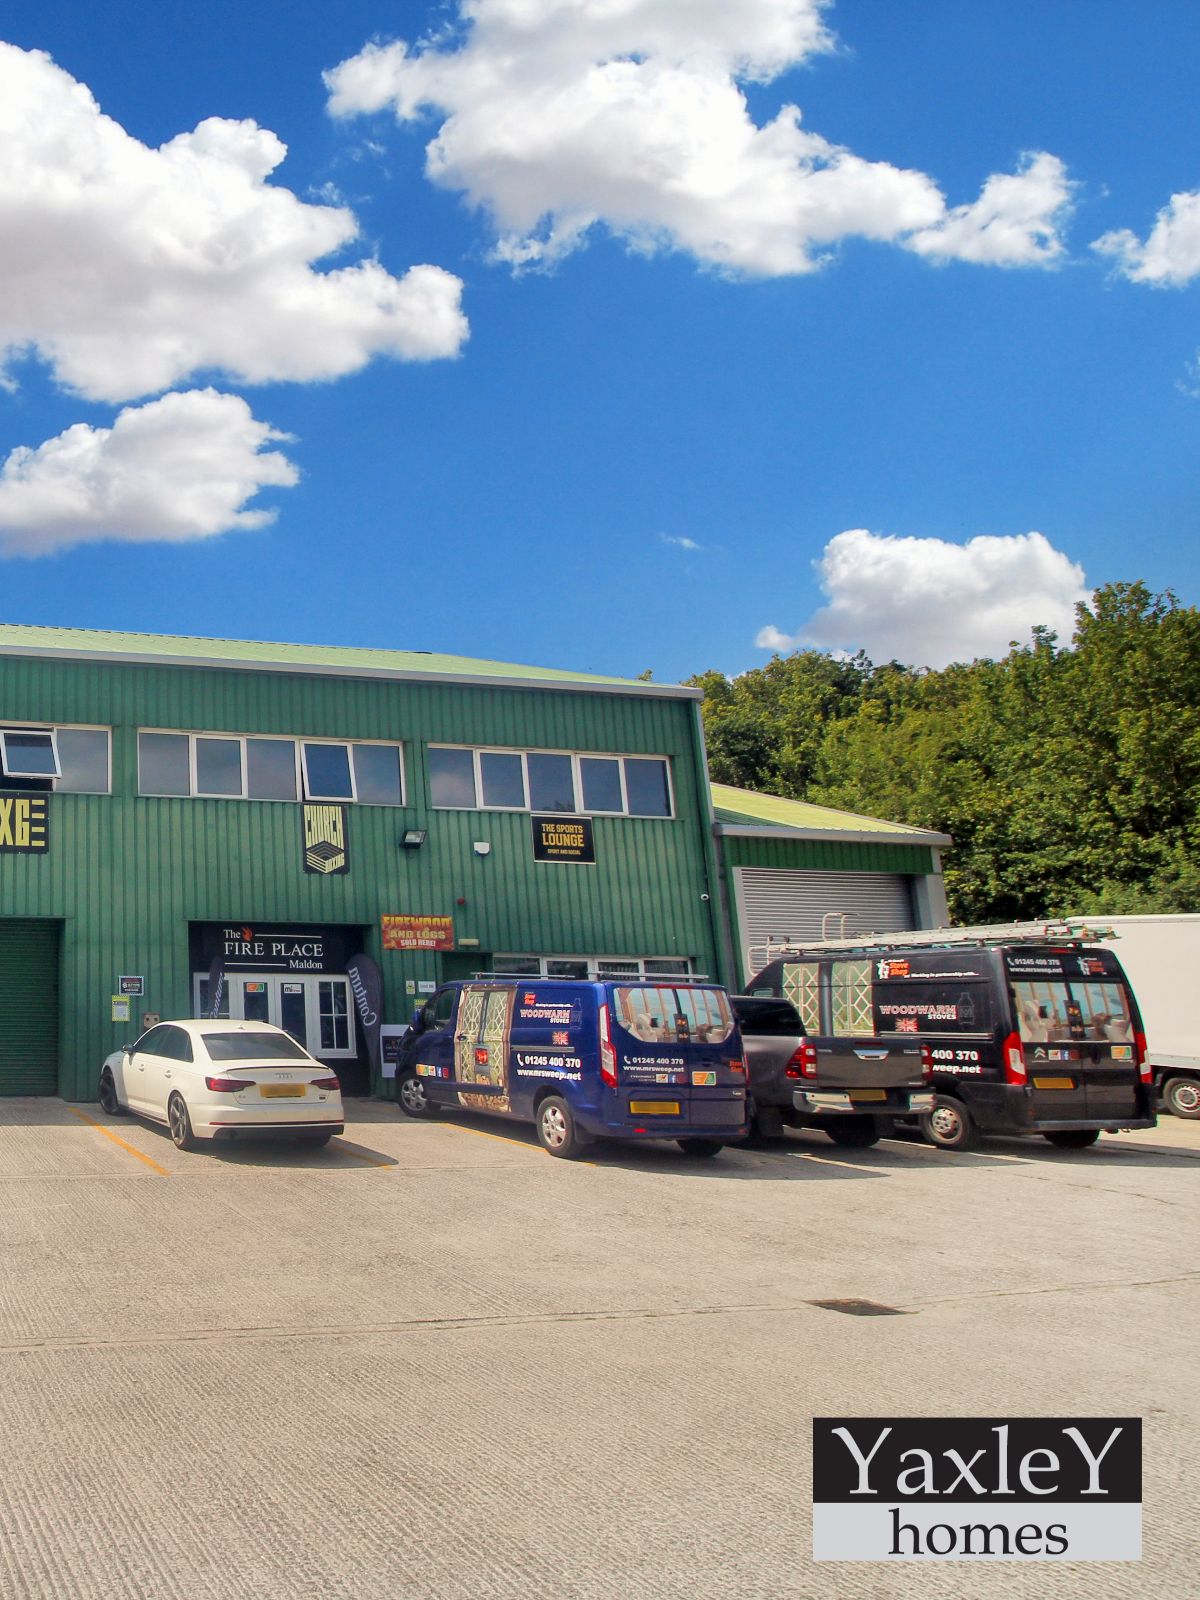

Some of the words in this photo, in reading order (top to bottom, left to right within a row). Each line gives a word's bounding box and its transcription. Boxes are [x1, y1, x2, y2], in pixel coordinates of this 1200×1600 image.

[303, 805, 345, 850] CHURCH
[541, 823, 556, 832] THE
[556, 824, 583, 833] SPORTS
[542, 833, 585, 847] LOUNGE
[383, 916, 453, 927] FIREWOOD
[223, 929, 241, 939] The
[390, 929, 414, 939] AND
[416, 927, 446, 940] LOGS
[400, 938, 417, 946] SOLD
[417, 939, 436, 947] HERE!
[224, 942, 265, 955] FIRE
[271, 943, 324, 957] PLACE
[289, 959, 323, 969] Maldon
[520, 1009, 571, 1018] WOODWARM
[879, 1005, 957, 1015] WOODWARM
[931, 1049, 954, 1059] 400
[955, 1050, 979, 1061] 370
[525, 1055, 548, 1066] 01245
[549, 1056, 564, 1067] 400
[565, 1058, 581, 1068] 370
[517, 1068, 582, 1081] www.mrsweep.net
[623, 1065, 685, 1073] www.mrsweep.net
